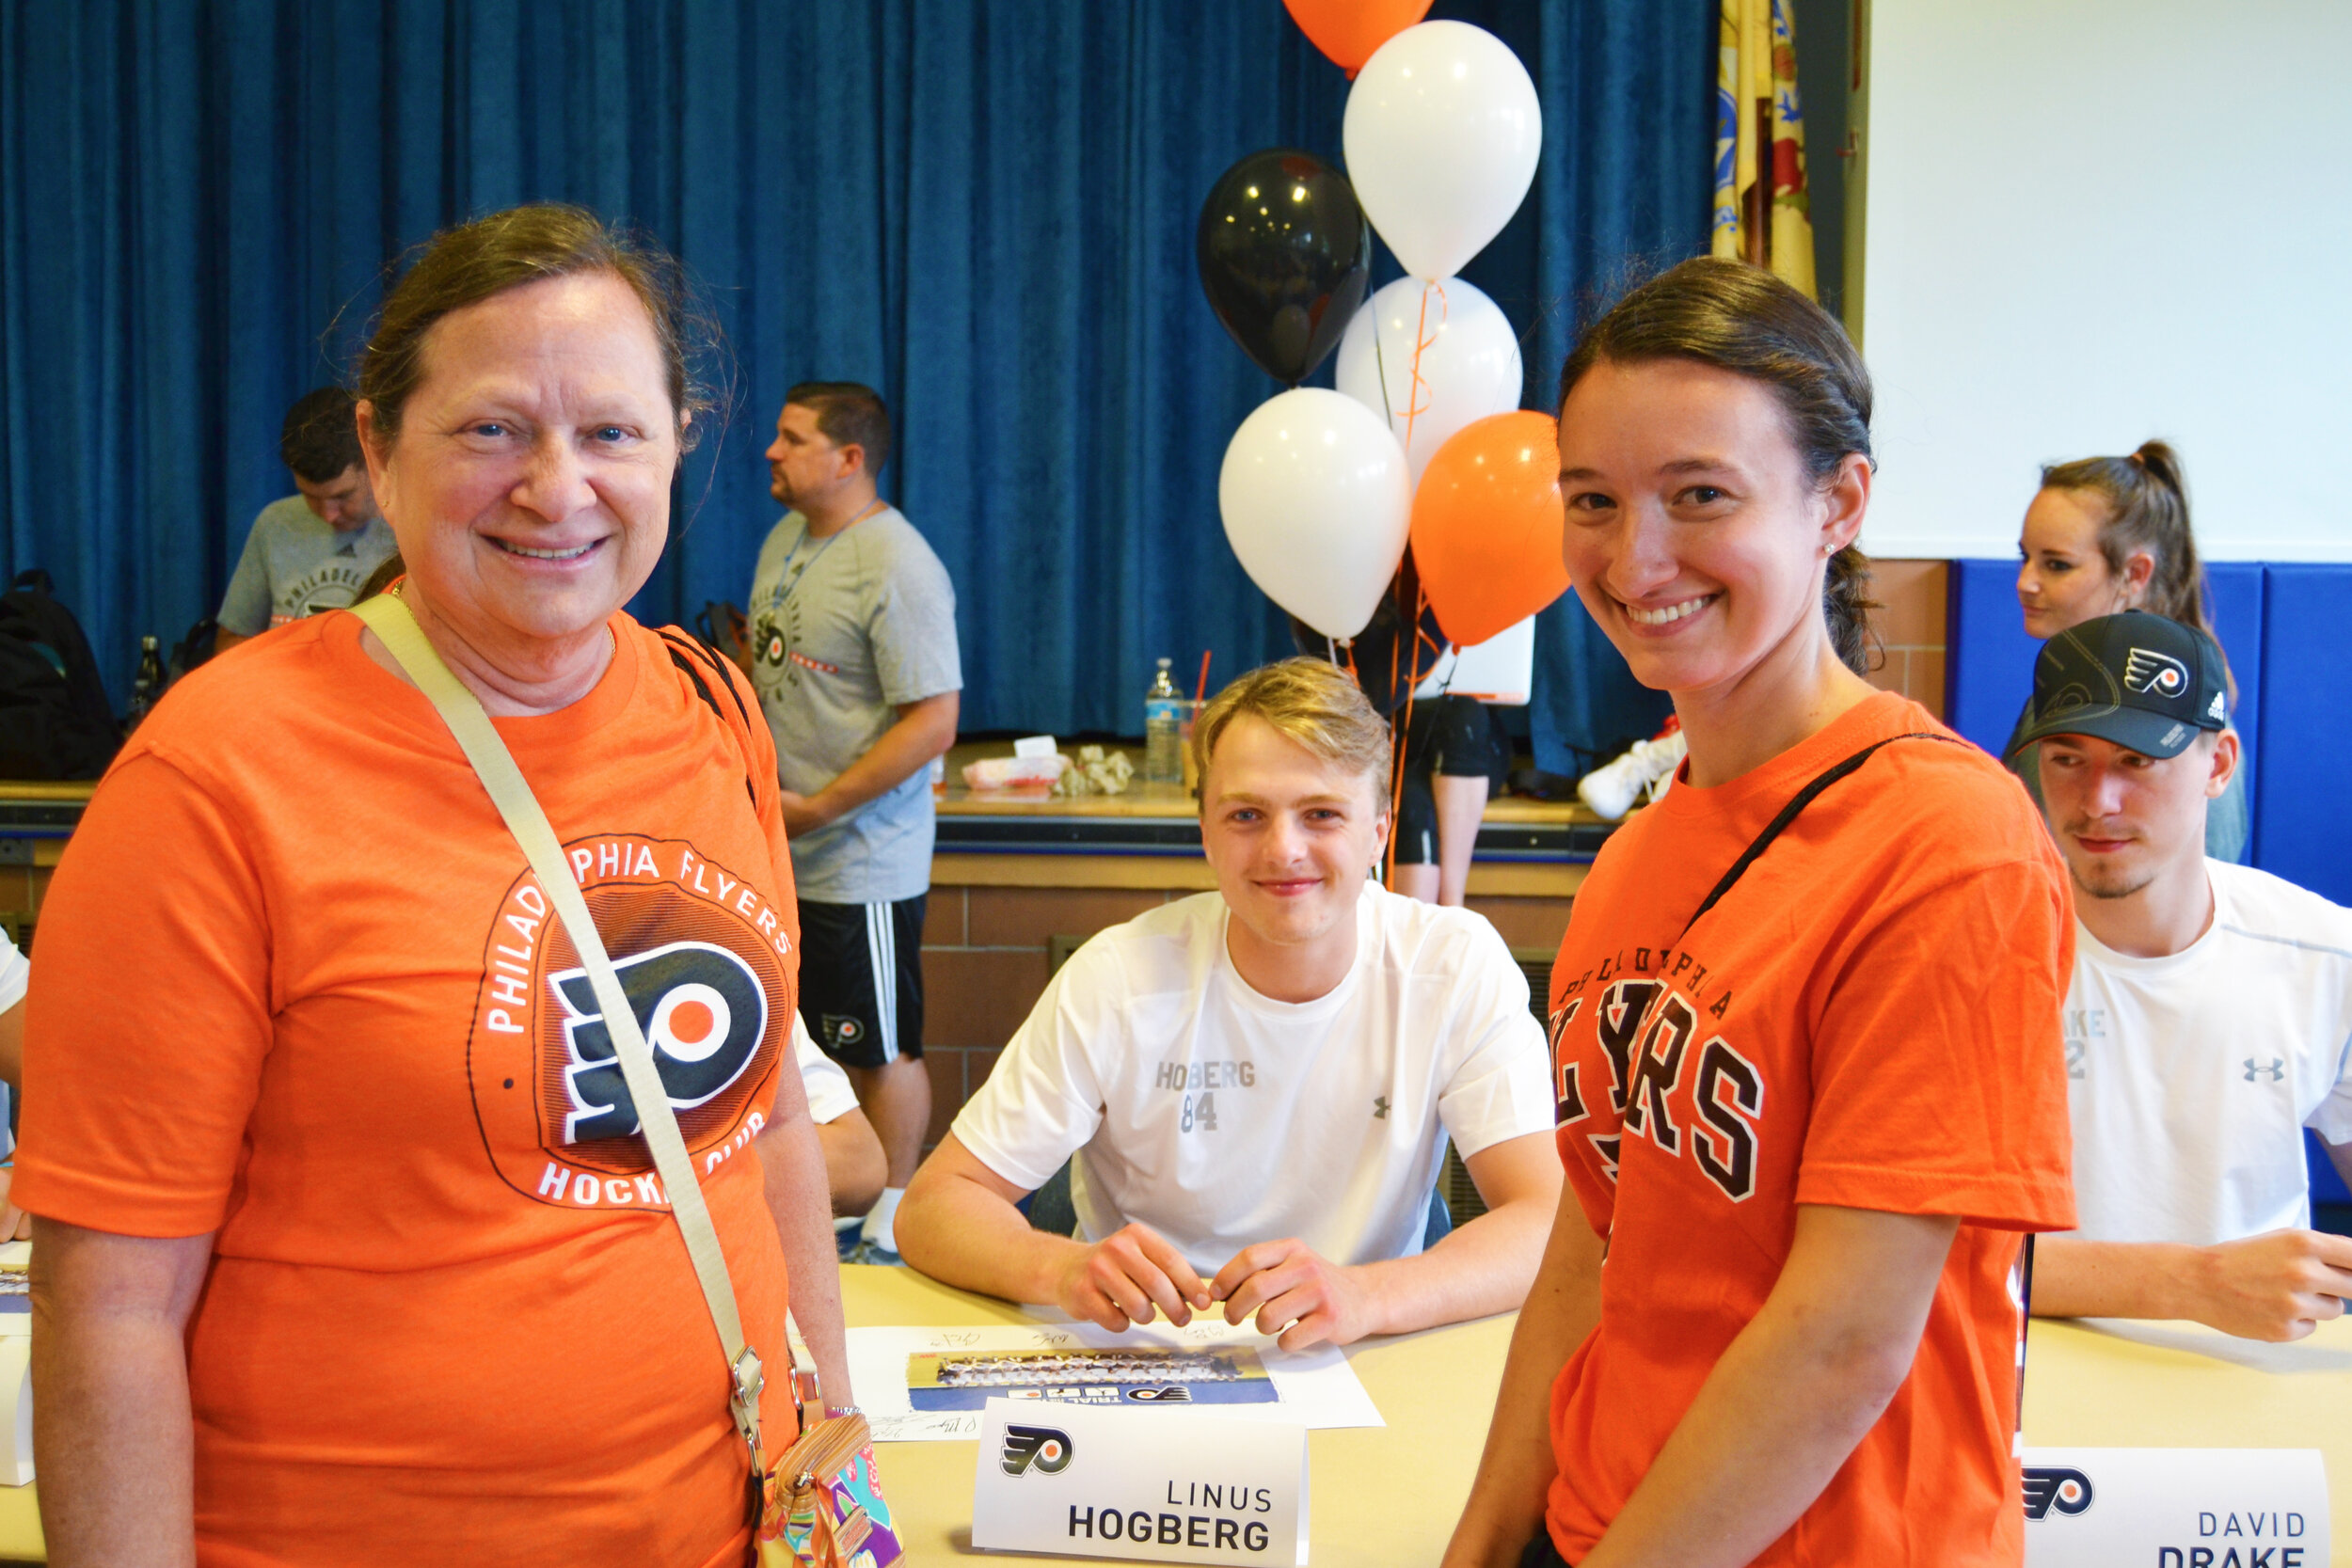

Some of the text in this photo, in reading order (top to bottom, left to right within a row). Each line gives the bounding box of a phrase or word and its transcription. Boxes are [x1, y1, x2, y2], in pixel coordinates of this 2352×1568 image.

[488, 843, 793, 1033] PHILADPHIA FLYERS
[1181, 1092, 1218, 1133] 84
[538, 1163, 672, 1204] HOCK
[1168, 1480, 1271, 1513] LINUS
[1069, 1504, 1270, 1552] HOGBERG
[2199, 1512, 2305, 1537] DAVID
